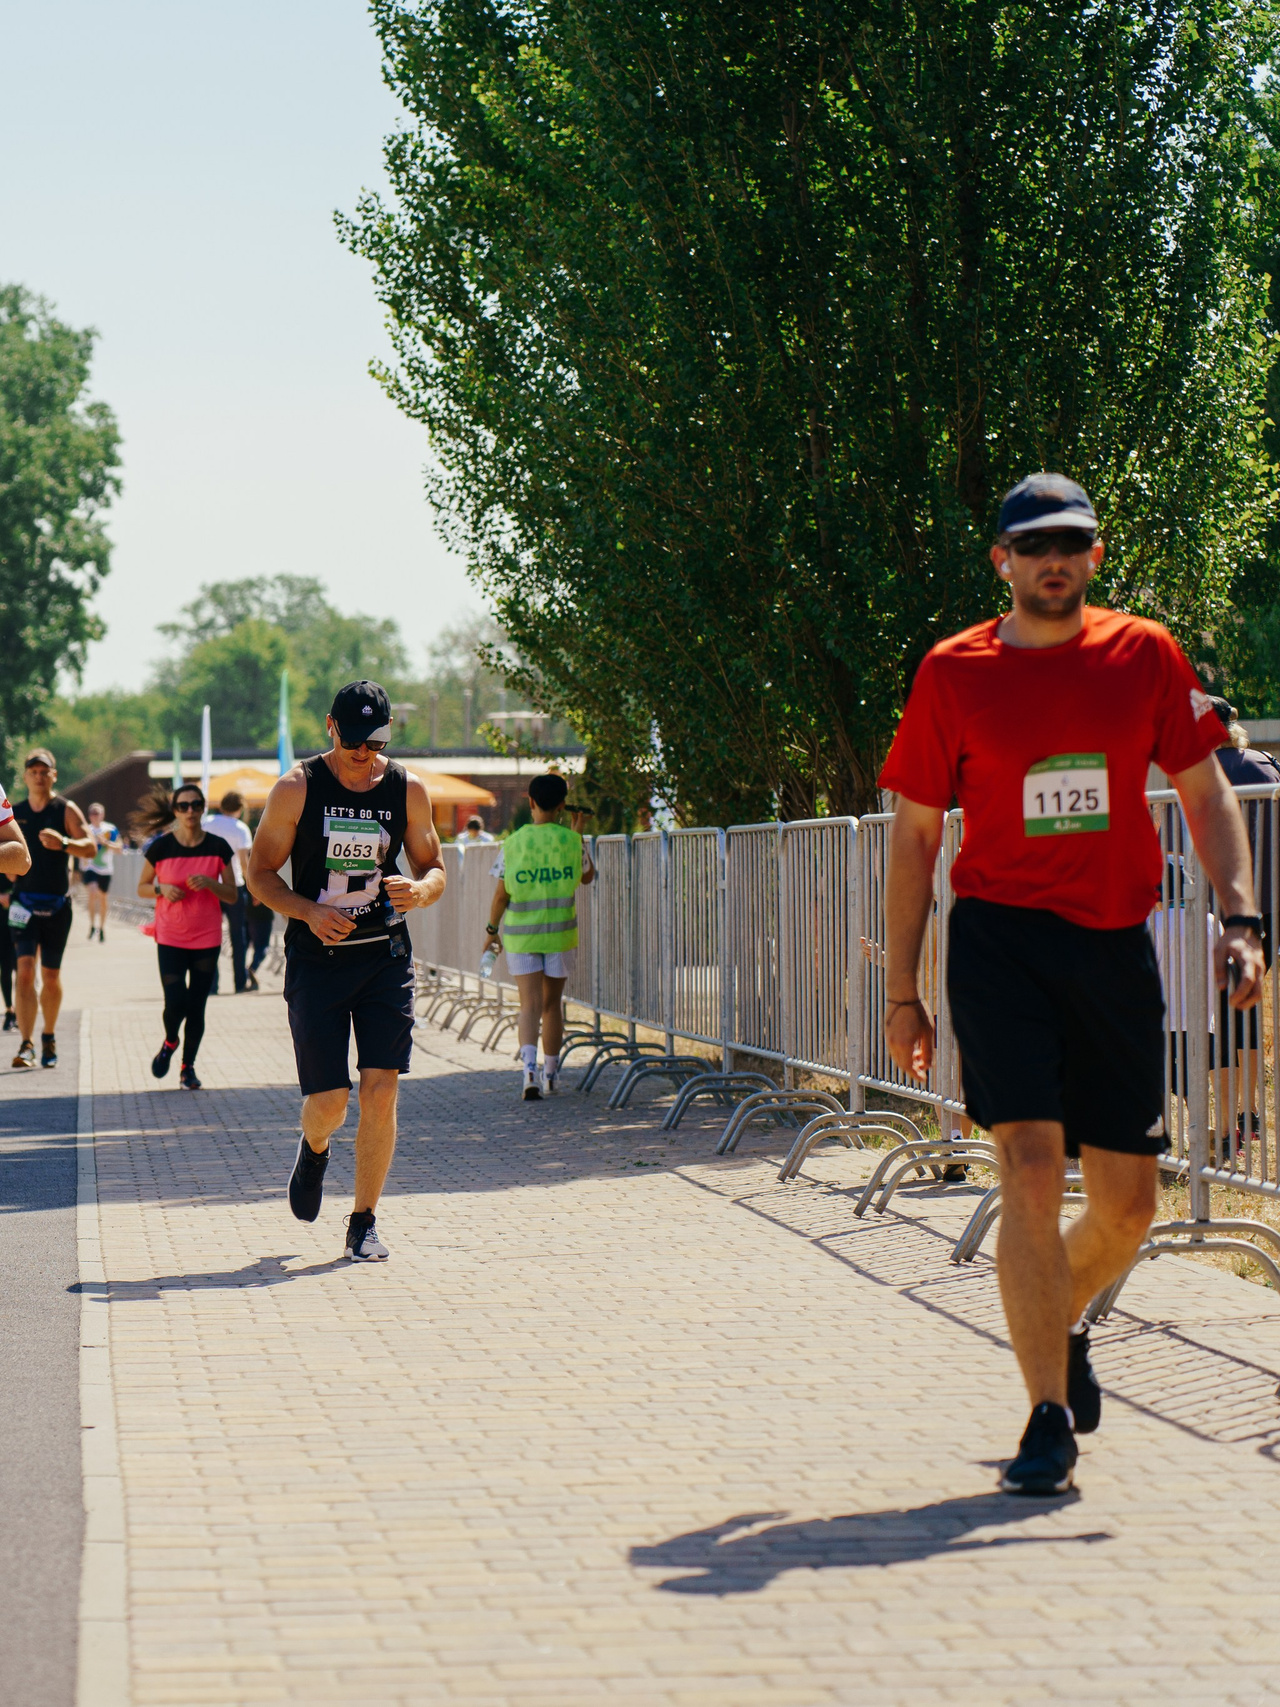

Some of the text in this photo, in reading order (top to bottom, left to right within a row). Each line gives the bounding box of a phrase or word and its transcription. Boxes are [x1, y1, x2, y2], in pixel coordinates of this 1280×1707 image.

[1035, 788, 1099, 815] 1125
[324, 806, 392, 820] LET'S GO TO
[332, 843, 373, 858] 0653
[515, 866, 574, 884] СУДЬЯ
